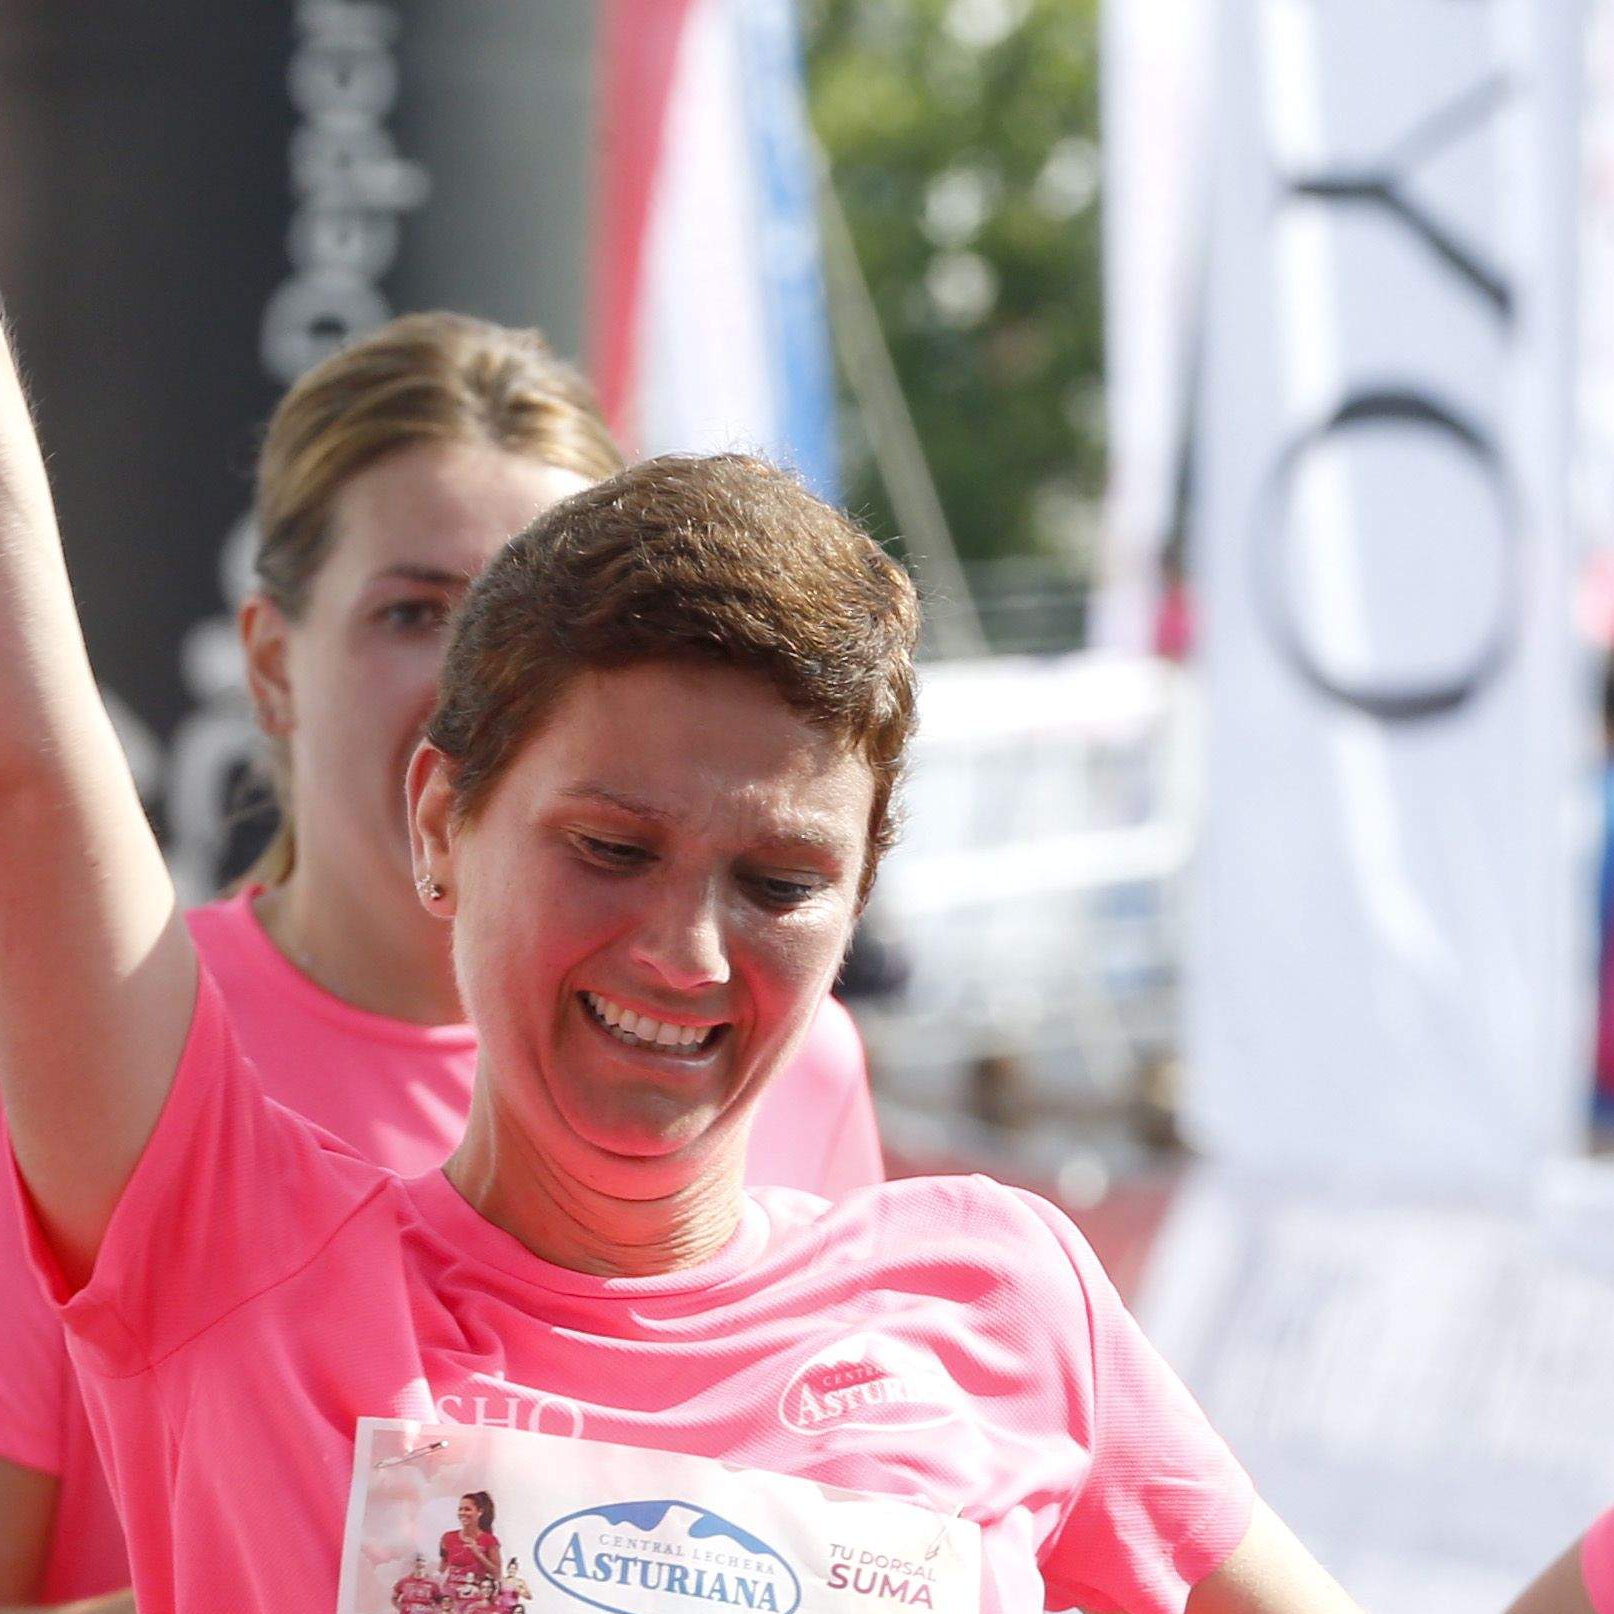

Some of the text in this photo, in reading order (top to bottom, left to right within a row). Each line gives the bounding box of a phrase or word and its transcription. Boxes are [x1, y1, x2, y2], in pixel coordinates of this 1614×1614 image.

[552, 1530, 781, 1614] ASTURIANA
[598, 1532, 776, 1576] CENTRAL LECHERA
[829, 1542, 938, 1583] TU DORSAL
[827, 1562, 935, 1611] SUMA
